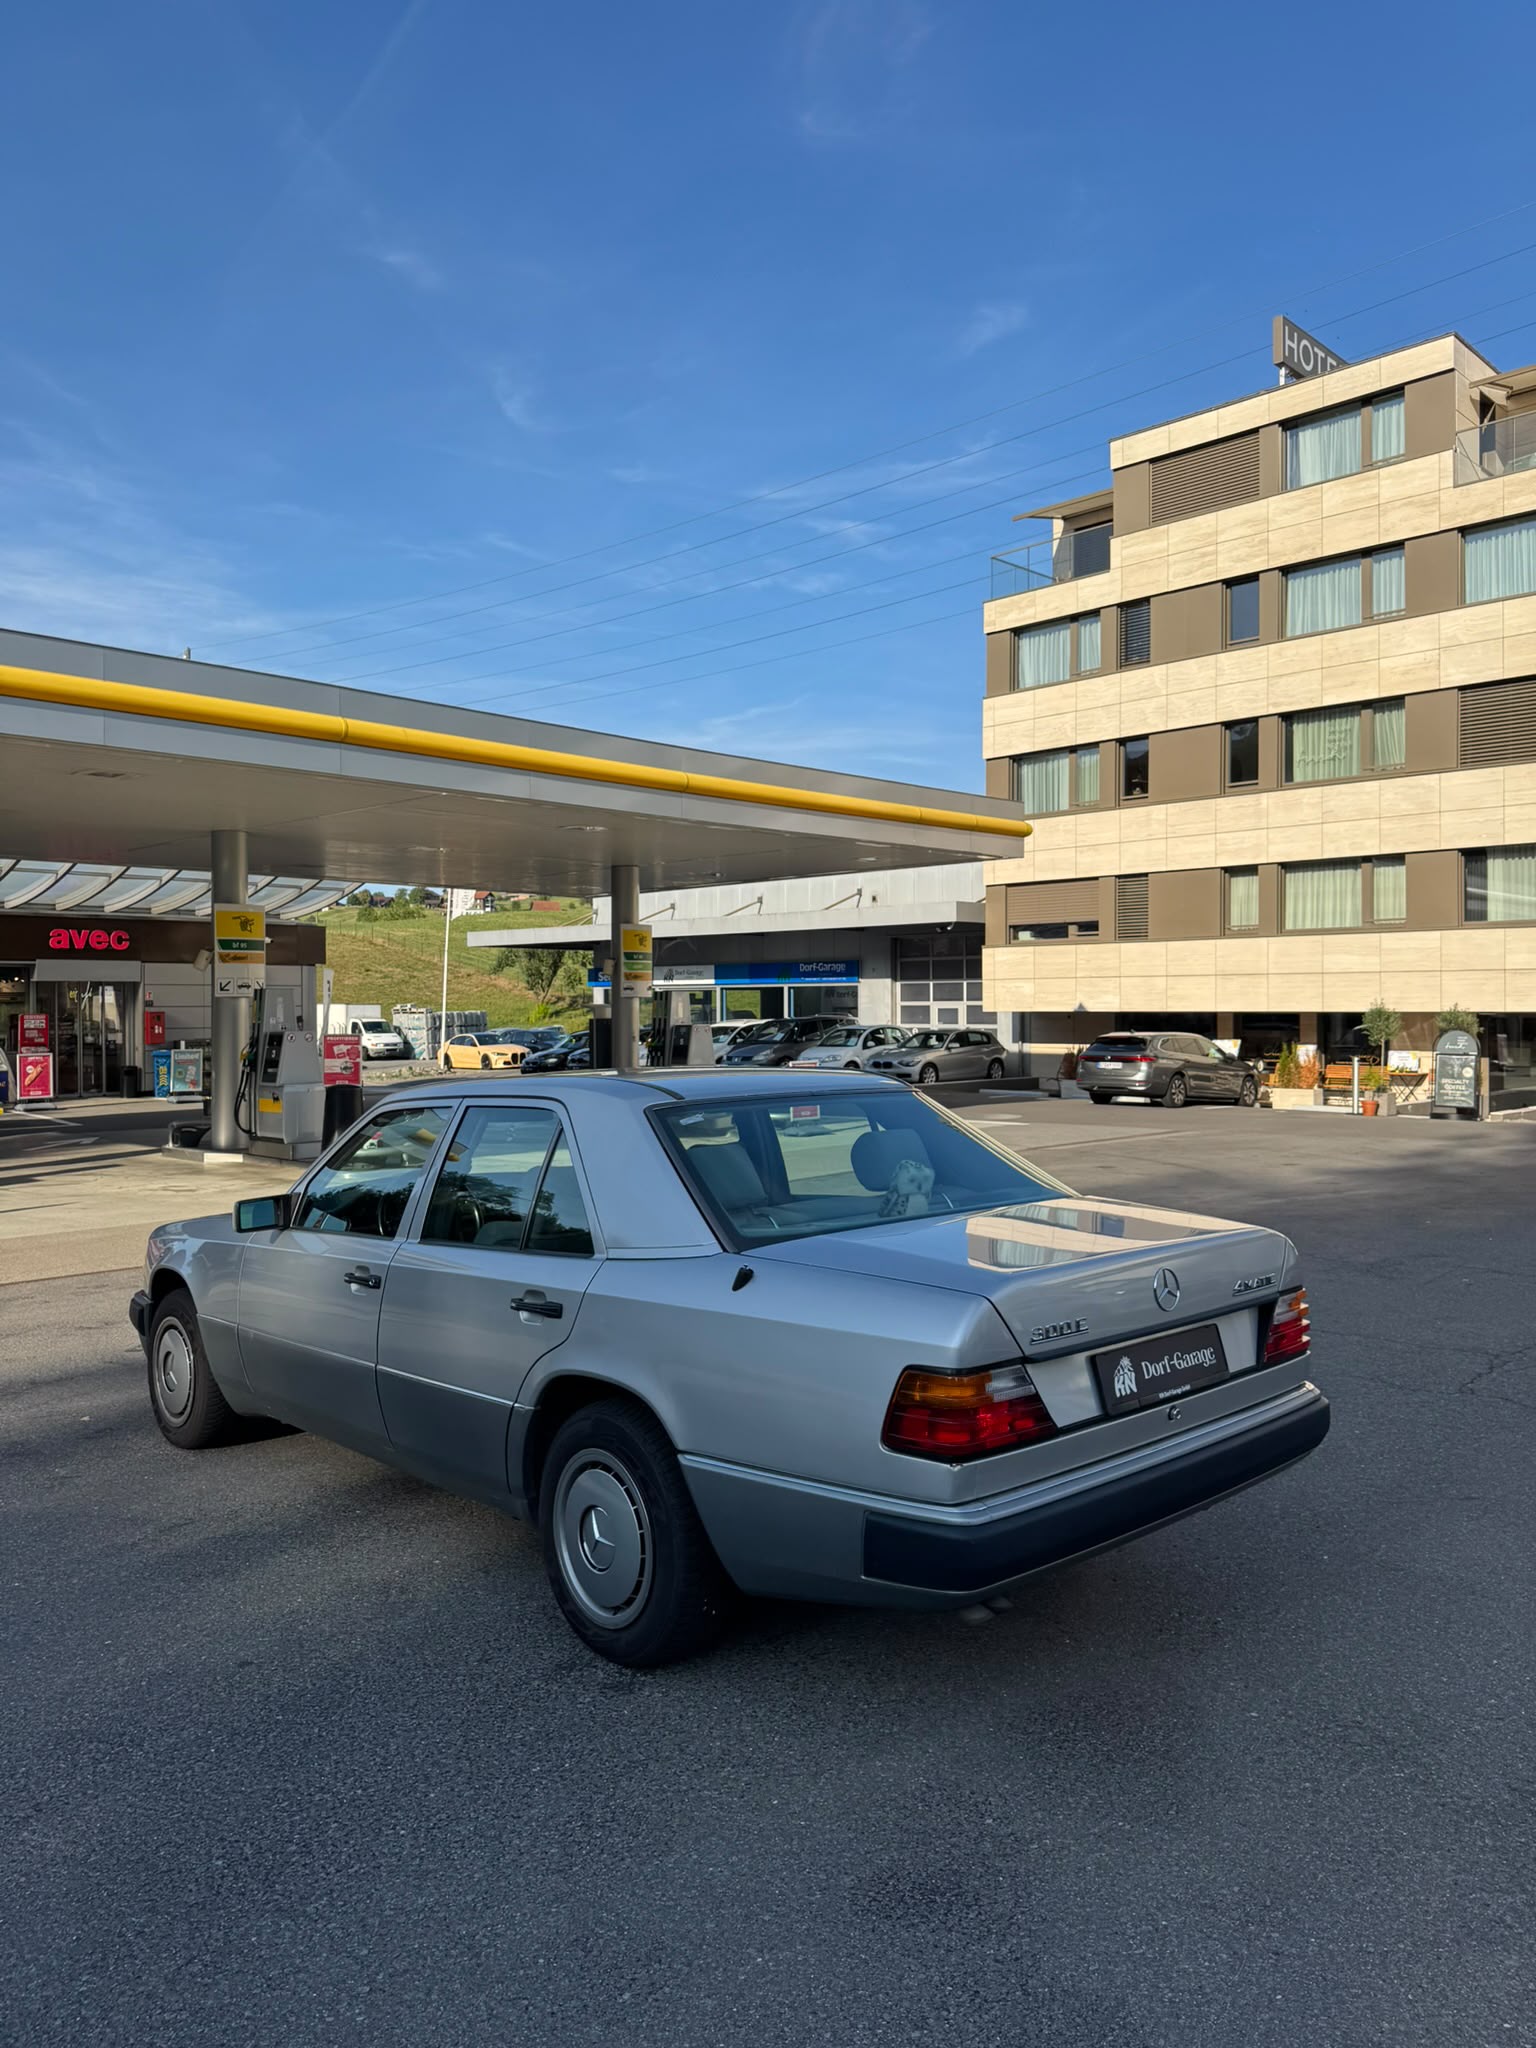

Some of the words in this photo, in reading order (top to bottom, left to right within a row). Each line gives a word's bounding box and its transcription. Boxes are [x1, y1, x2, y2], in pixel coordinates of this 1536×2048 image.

[49, 928, 130, 951] avec
[800, 963, 847, 972] Dorf-Garage
[1233, 1272, 1276, 1291] 4MATIC
[1141, 1346, 1216, 1379] Dorf-Garage
